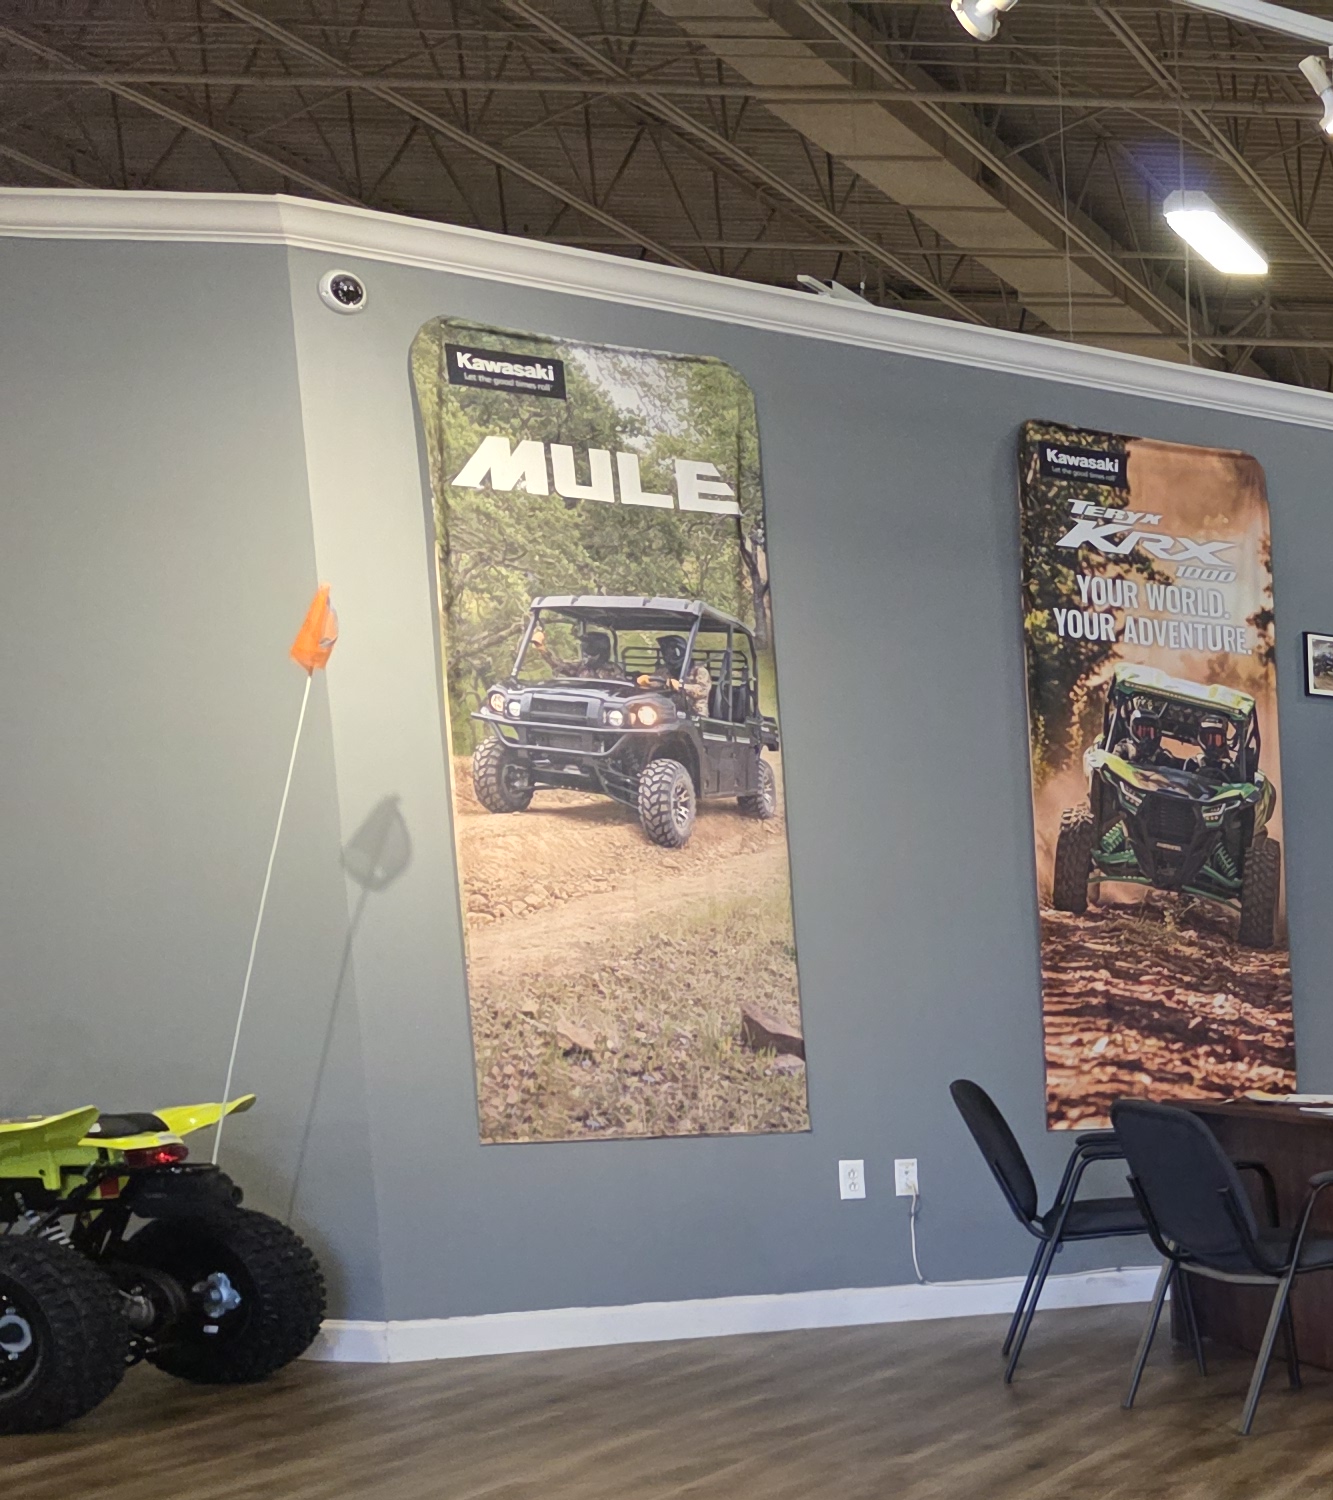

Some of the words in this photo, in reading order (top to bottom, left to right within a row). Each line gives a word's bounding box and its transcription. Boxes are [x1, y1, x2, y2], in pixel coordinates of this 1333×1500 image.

[456, 351, 555, 381] Kawasaki
[463, 372, 477, 381] Let
[478, 374, 492, 384] the
[493, 377, 515, 387] good
[515, 380, 537, 390] times
[451, 435, 743, 515] MULE
[1046, 448, 1119, 472] Kawasaki
[1055, 519, 1236, 567] KRX
[1176, 565, 1237, 584] 1000
[1076, 574, 1138, 609] YOUR
[1147, 582, 1231, 620] WORLD.
[1053, 607, 1115, 642] YOUR
[1124, 615, 1253, 655] ADVENTURE.
